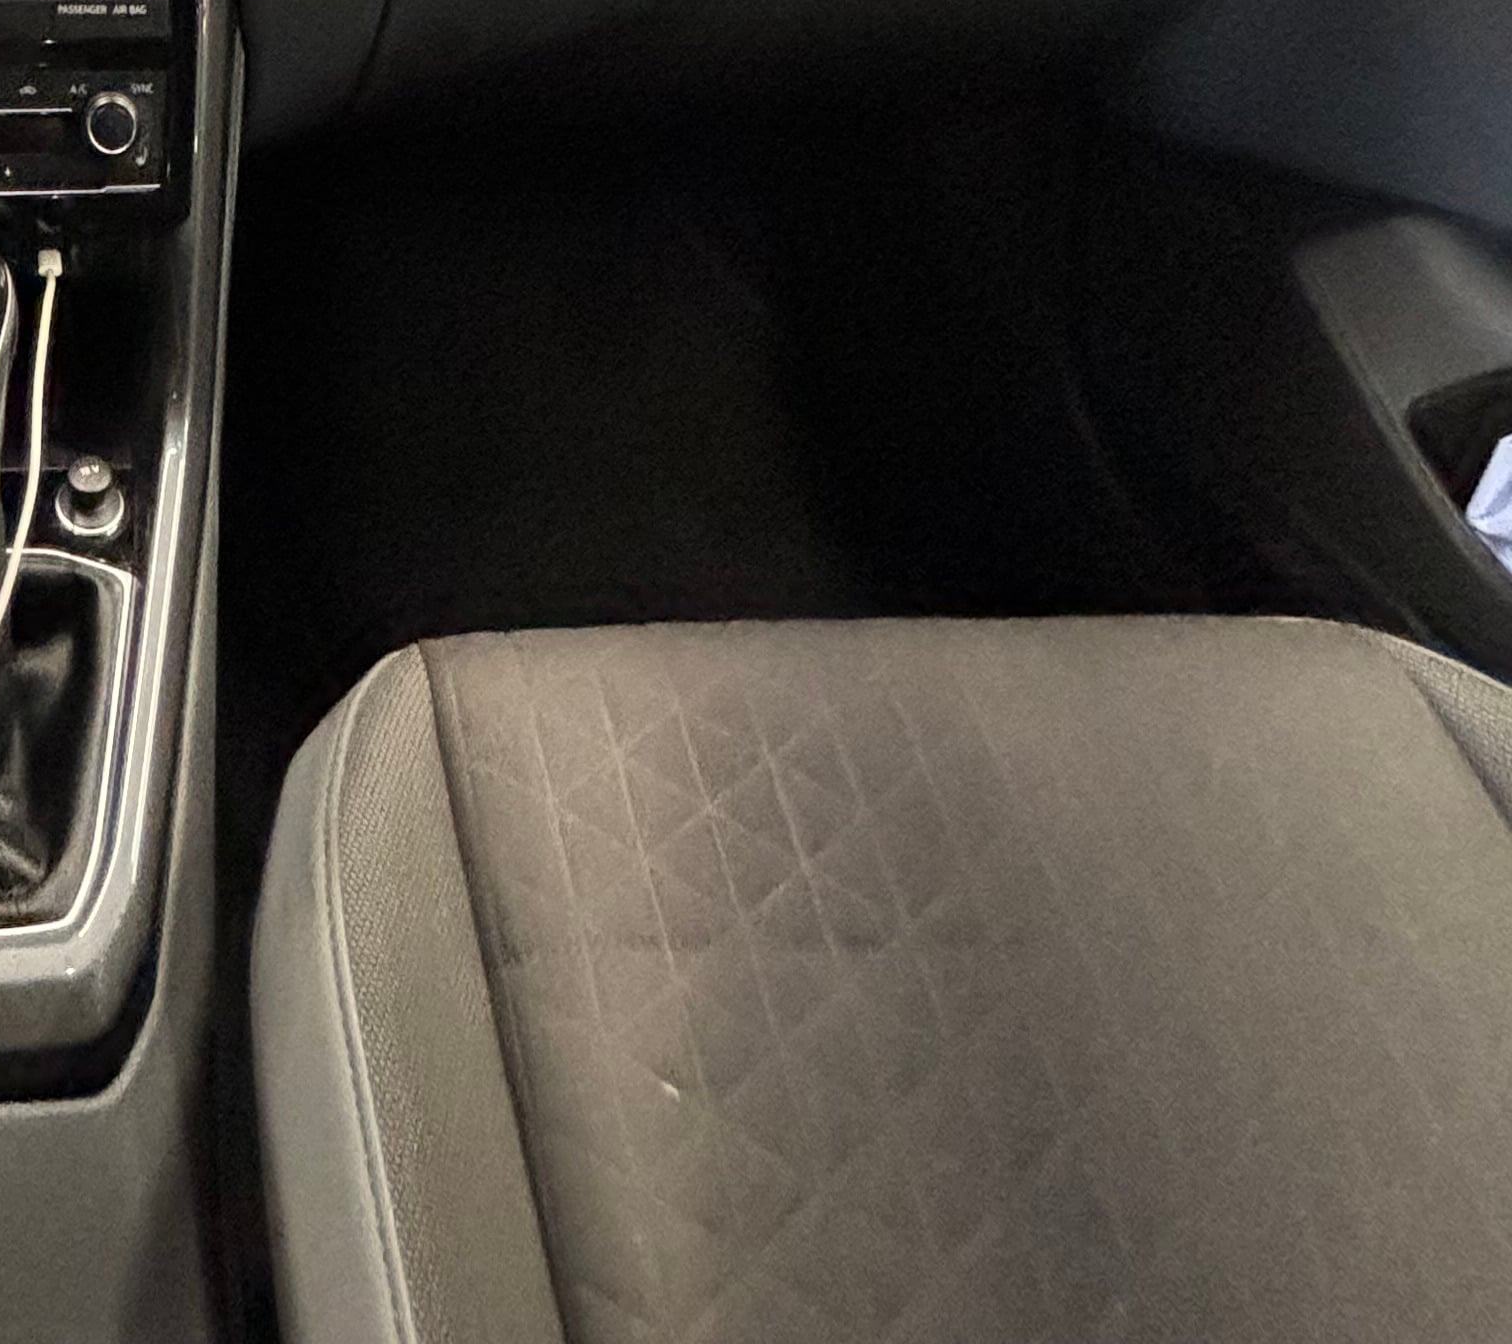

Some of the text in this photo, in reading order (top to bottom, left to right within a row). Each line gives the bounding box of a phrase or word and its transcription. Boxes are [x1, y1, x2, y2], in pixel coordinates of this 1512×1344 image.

[57, 4, 148, 16] PASSENGER AIR BAG
